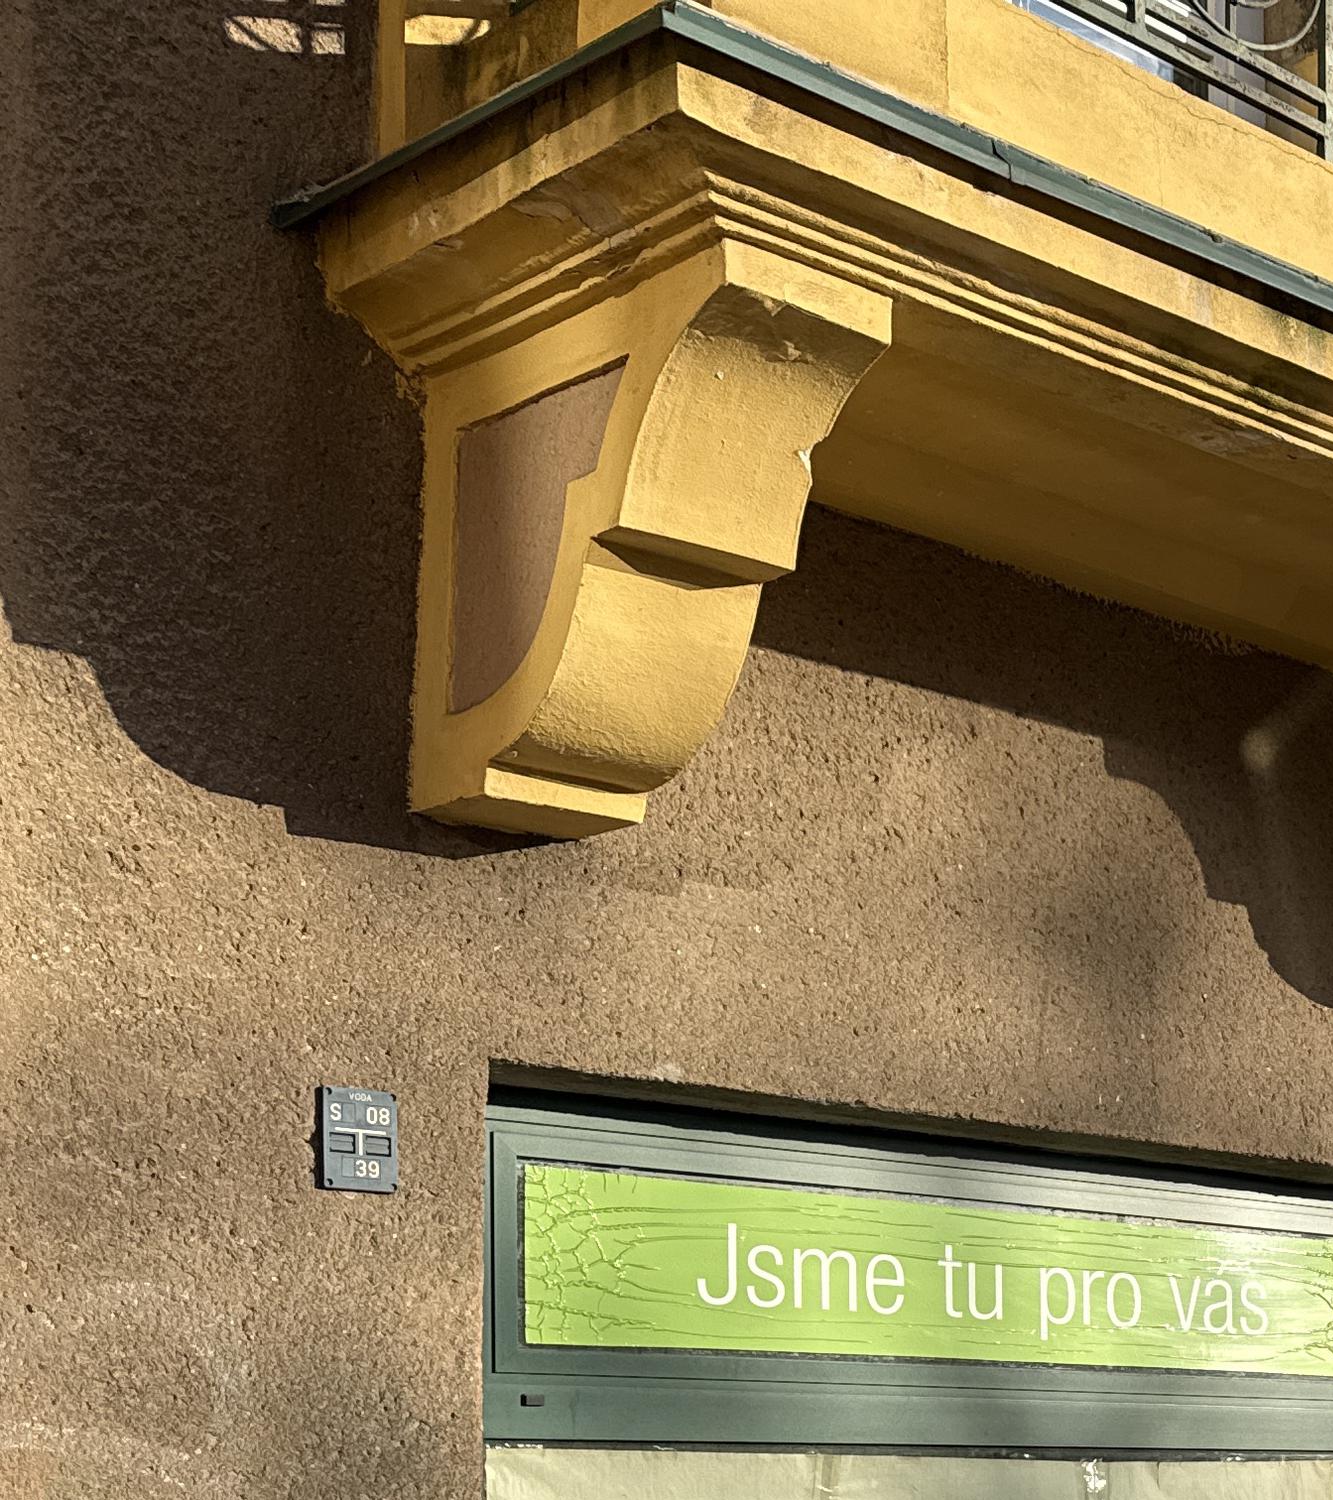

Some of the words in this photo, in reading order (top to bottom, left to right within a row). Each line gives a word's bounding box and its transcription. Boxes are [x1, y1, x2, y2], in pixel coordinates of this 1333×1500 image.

[329, 1102, 342, 1121] S
[366, 1106, 391, 1126] 08
[355, 1159, 380, 1179] 39
[695, 1222, 907, 1317] Jsme
[937, 1244, 1004, 1322] tu
[1039, 1264, 1144, 1342] pro
[1165, 1260, 1271, 1337] vás
